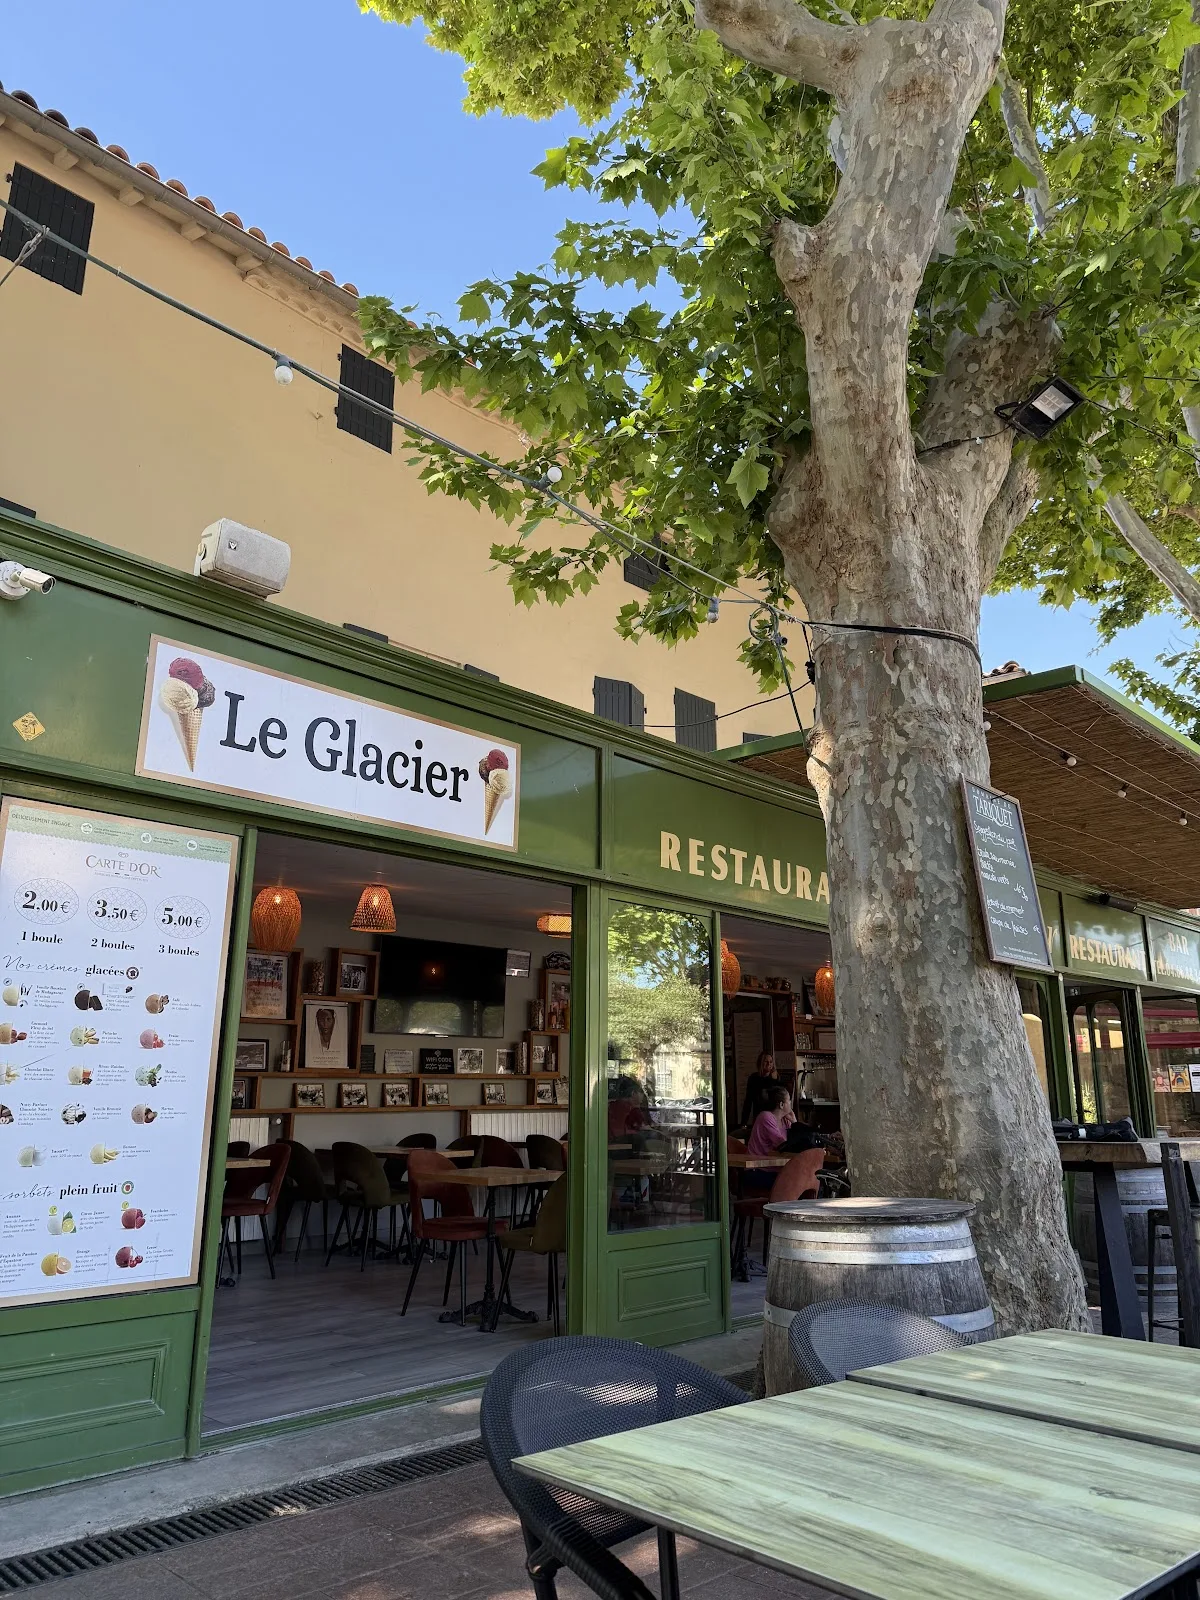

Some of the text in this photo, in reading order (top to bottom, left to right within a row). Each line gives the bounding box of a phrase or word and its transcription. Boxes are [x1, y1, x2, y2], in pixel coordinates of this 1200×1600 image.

[219, 690, 469, 803] Le Glacier
[973, 795, 1013, 827] TARIQUET
[85, 854, 124, 871] CARTE
[129, 862, 162, 878] D'OR
[660, 831, 831, 905] RESTAURA
[22, 890, 71, 914] 2.00€
[94, 899, 139, 922] 3.50€
[161, 907, 204, 928] 5.00€
[21, 931, 63, 944] 1 boule
[91, 938, 135, 951] 2 boules
[1167, 931, 1190, 956] BAR
[158, 945, 200, 957] 3 boules
[1069, 934, 1147, 971] RESTAURANT
[3, 955, 125, 978] Nos crèmes glacées
[59, 1184, 88, 1199] plein
[92, 1183, 118, 1195] fruit
